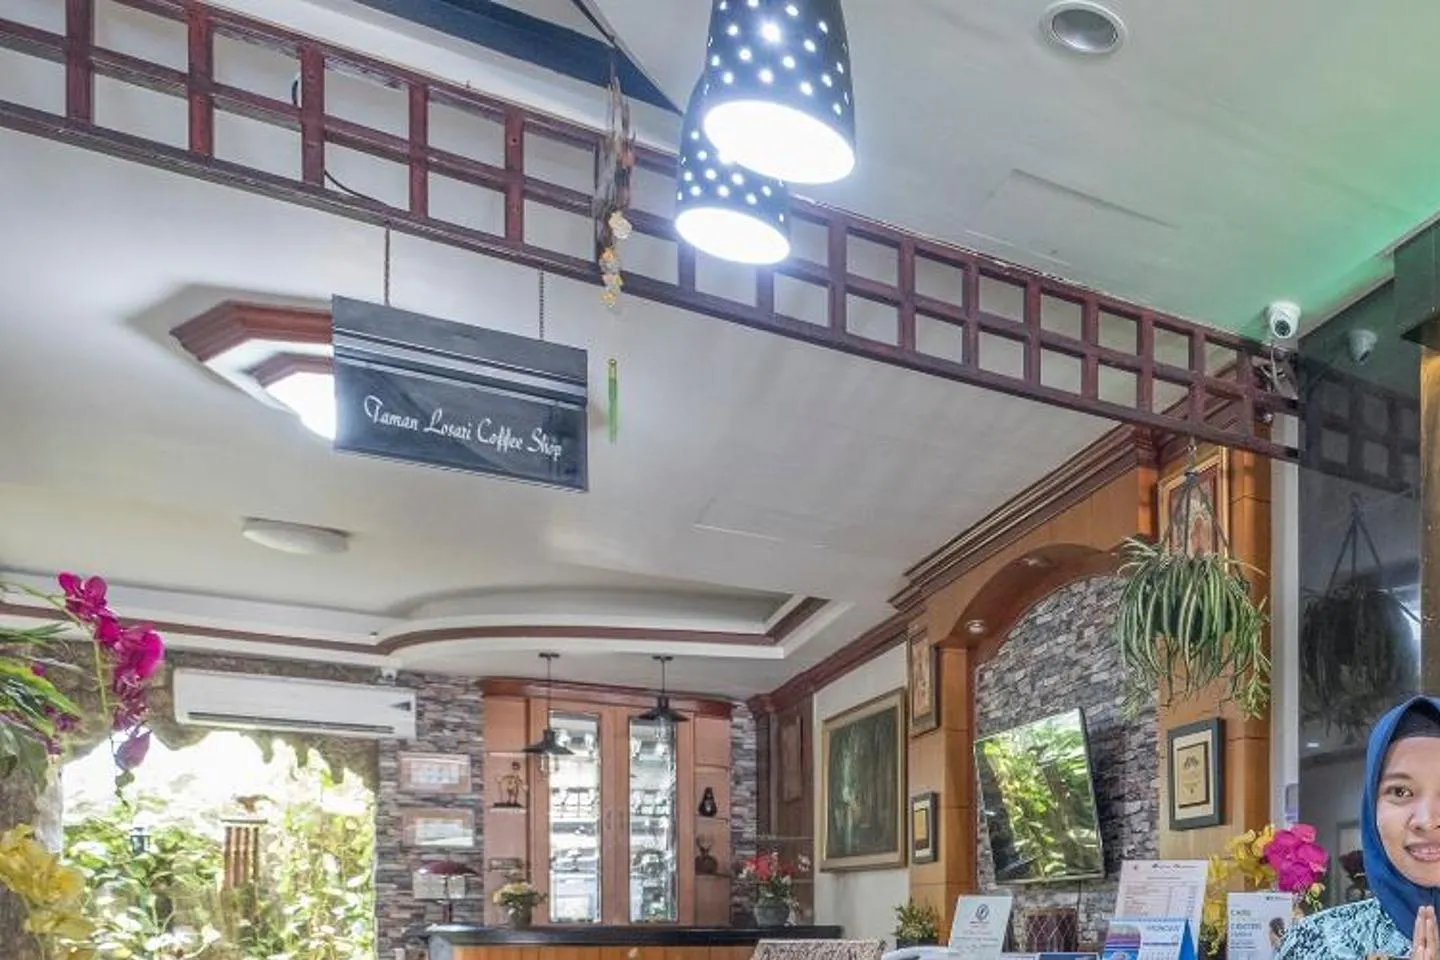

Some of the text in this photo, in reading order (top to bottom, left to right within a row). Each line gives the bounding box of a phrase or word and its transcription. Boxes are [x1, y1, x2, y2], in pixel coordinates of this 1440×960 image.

[364, 395, 562, 461] Taman Losari Coffee Shop
